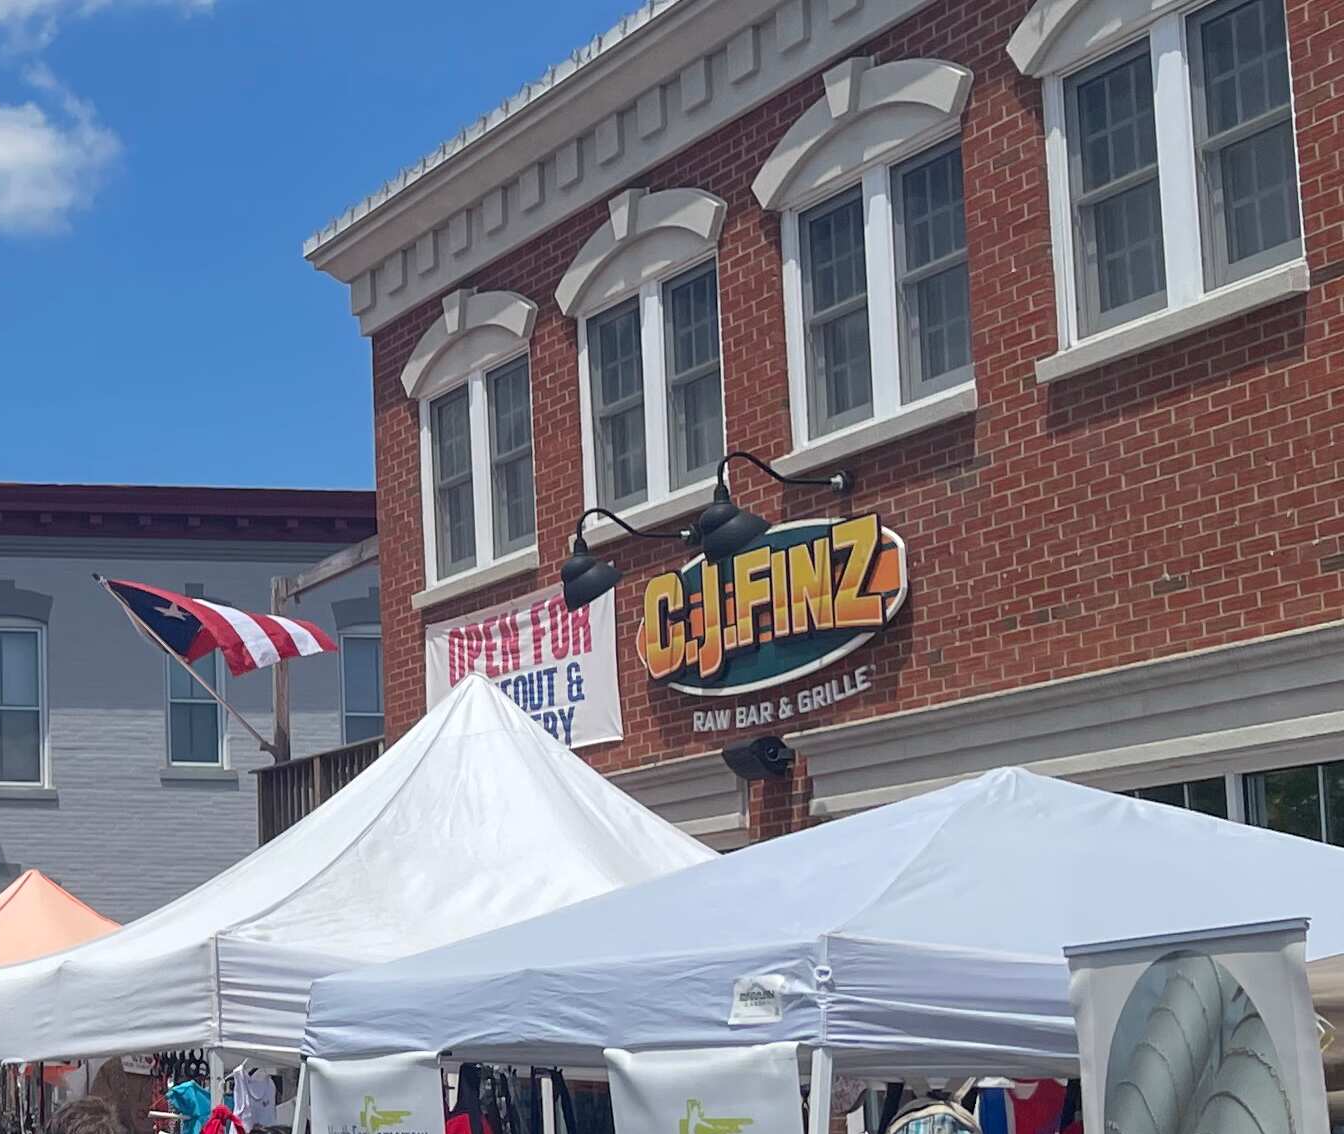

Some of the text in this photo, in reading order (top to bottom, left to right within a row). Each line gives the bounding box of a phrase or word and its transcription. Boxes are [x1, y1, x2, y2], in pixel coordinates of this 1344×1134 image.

[448, 594, 592, 688] OPEN FOR
[566, 661, 585, 702] &
[692, 665, 872, 732] RAW BAR & GRILLE
